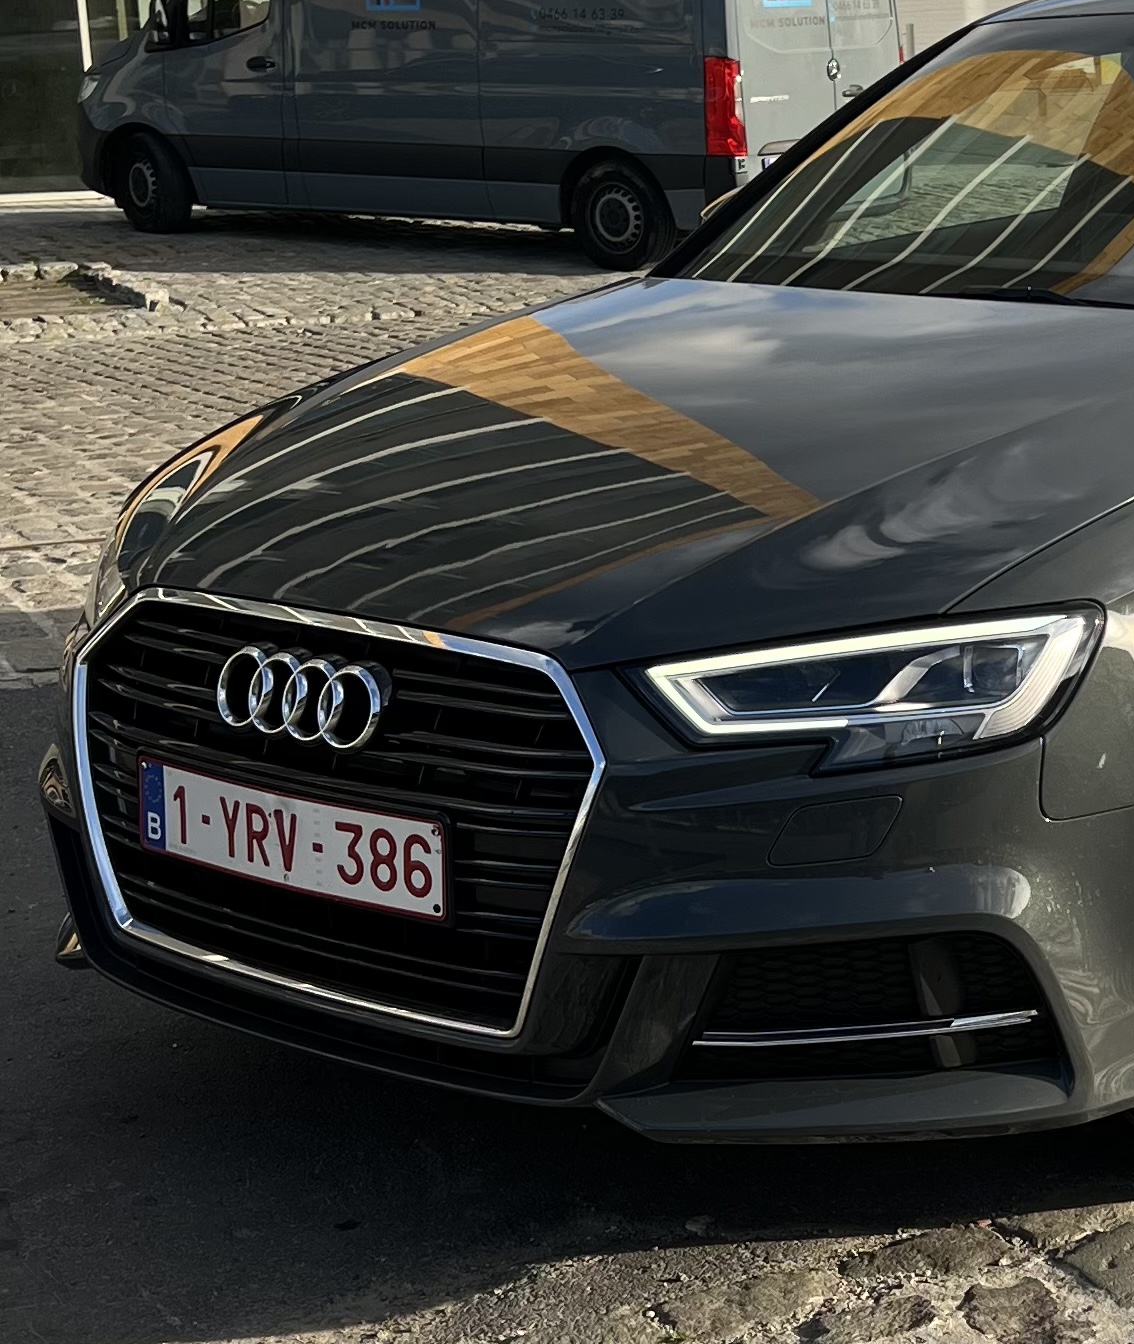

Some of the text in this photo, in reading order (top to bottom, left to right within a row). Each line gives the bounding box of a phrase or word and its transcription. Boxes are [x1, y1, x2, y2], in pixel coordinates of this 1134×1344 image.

[538, 7, 625, 21] 0466 14 63 39
[351, 19, 436, 31] MCM SOLUTION
[779, 15, 826, 28] SOLUTION
[147, 810, 162, 841] B
[173, 785, 433, 898] 1-YRV-386
